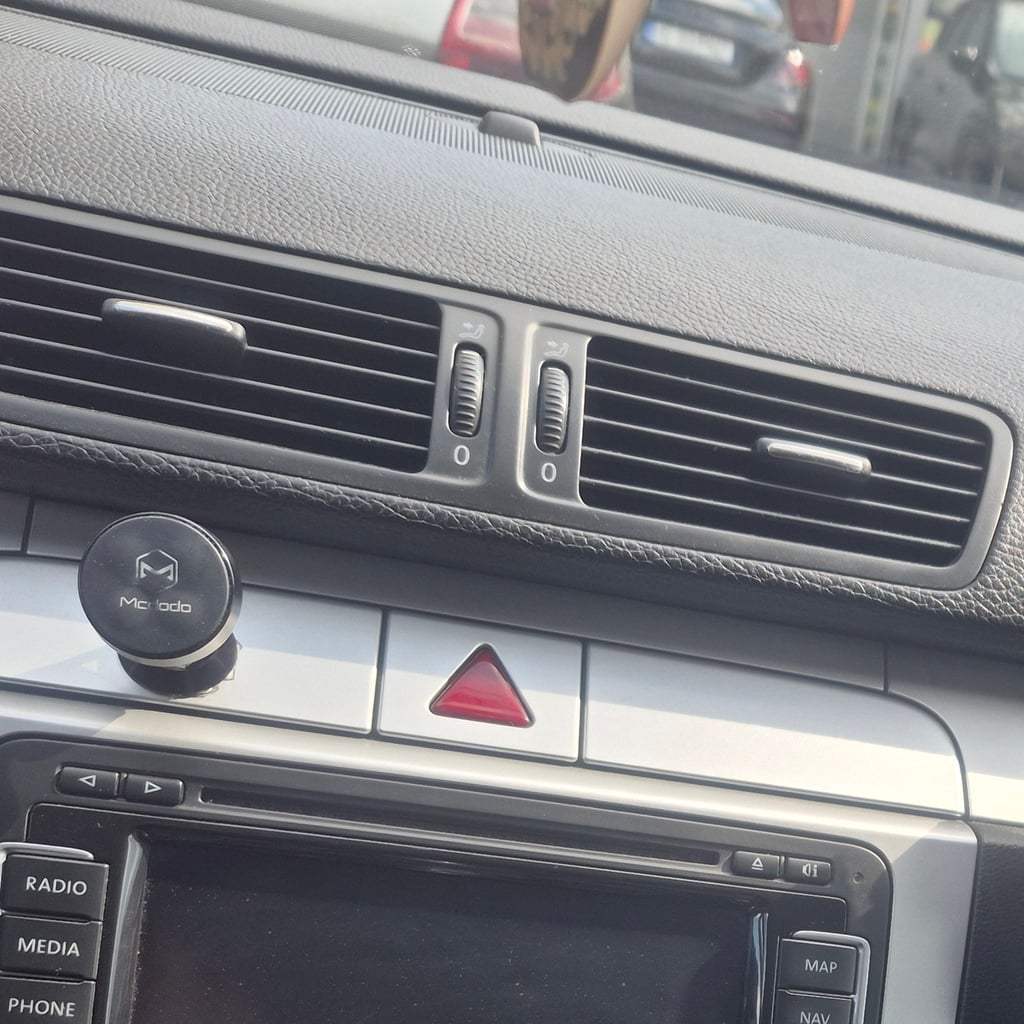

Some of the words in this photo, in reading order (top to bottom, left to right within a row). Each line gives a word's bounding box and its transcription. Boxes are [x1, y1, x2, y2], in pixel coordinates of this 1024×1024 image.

[453, 444, 471, 466] 0
[541, 462, 557, 483] 0
[26, 876, 88, 896] RADIO
[17, 937, 80, 957] MEDIA
[805, 958, 838, 975] MAP
[8, 997, 76, 1017] PHONE
